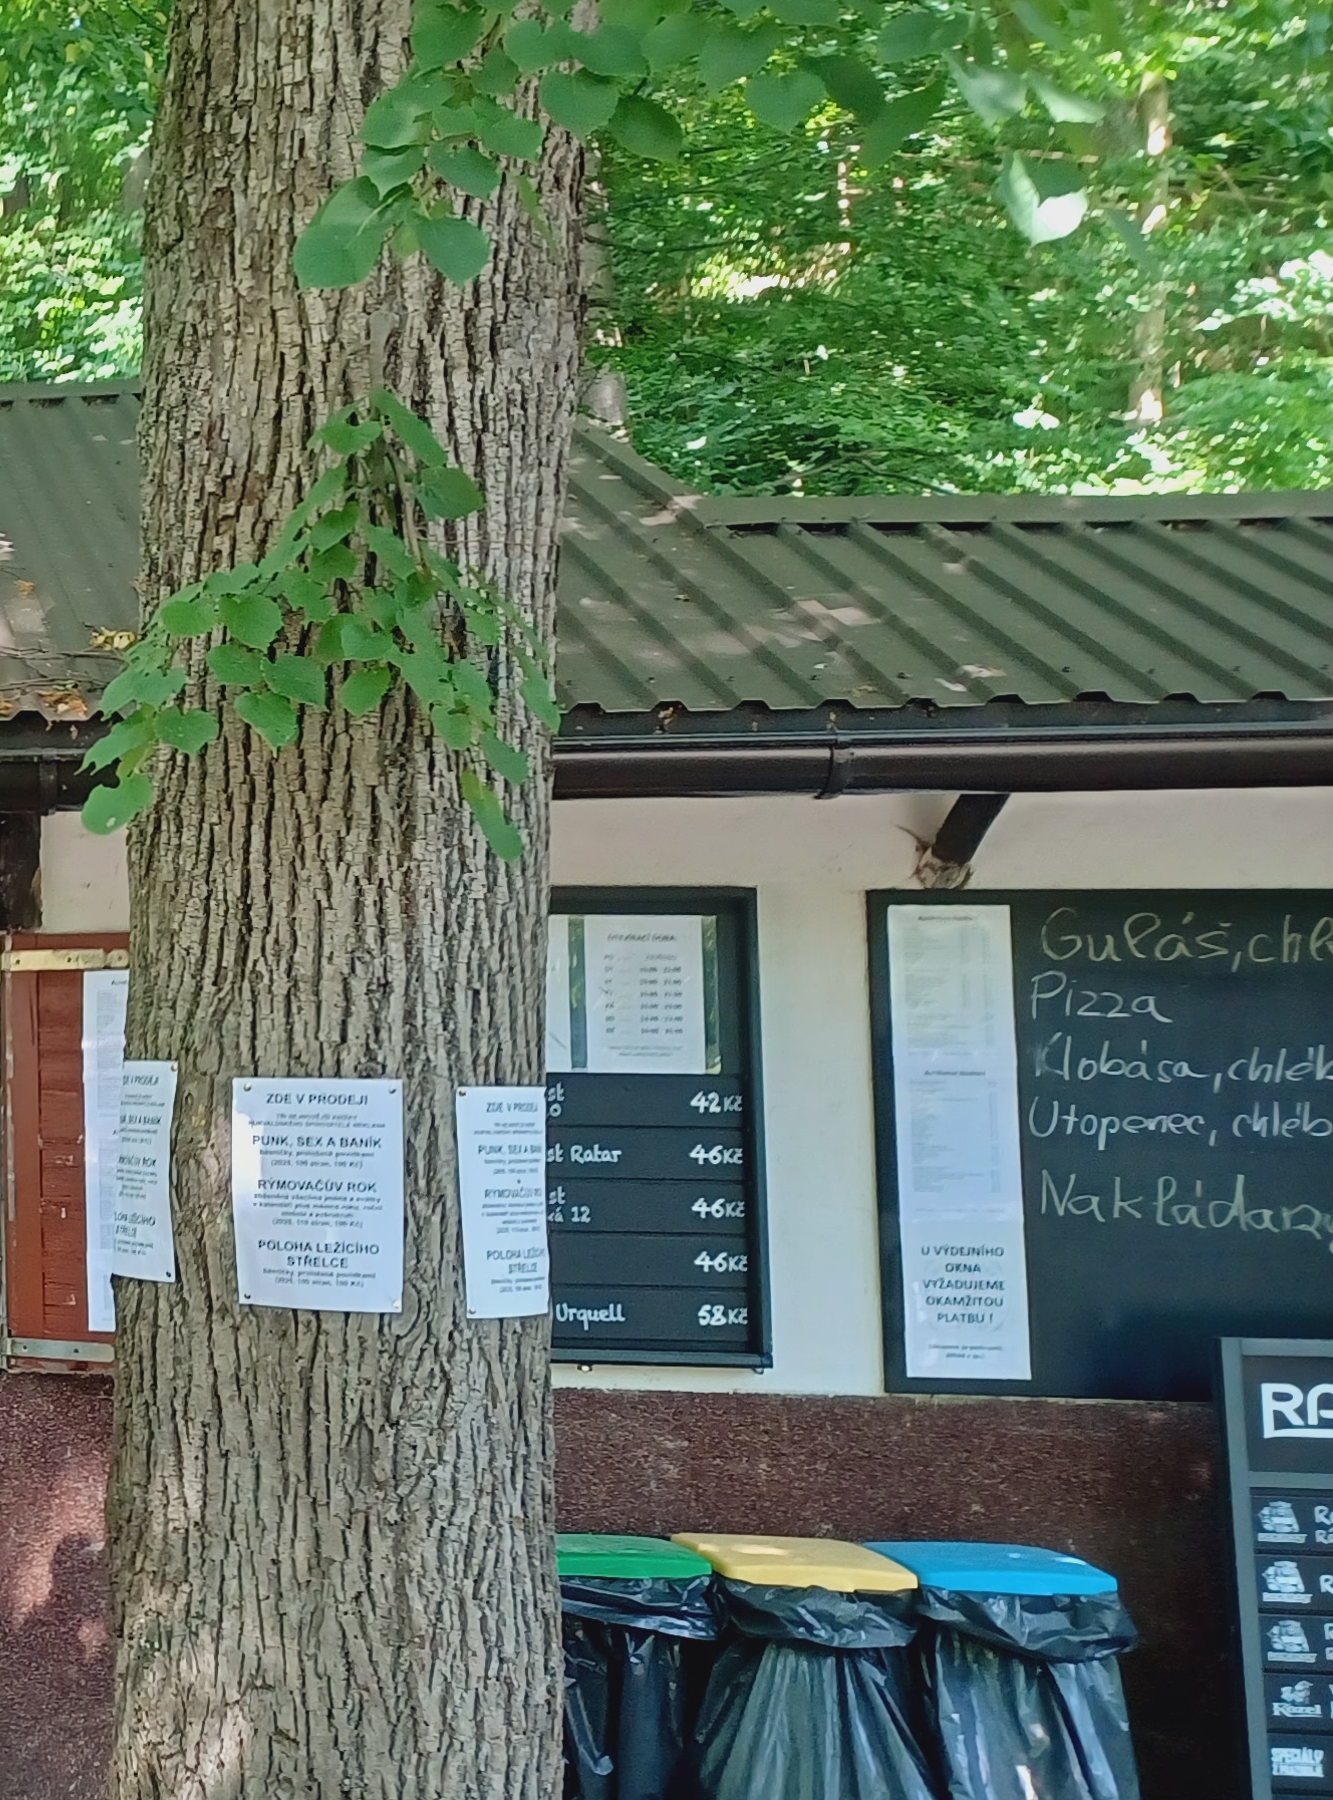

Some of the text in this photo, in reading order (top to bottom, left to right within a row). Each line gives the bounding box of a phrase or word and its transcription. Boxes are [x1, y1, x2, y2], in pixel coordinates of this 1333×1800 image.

[1031, 970, 1174, 1024] Pizza
[266, 1093, 369, 1106] ZDE V PRODEJI
[1028, 1096, 1333, 1151] Utopenec, chléb
[252, 1135, 382, 1149] PUNK, SEX A BANÍK
[570, 1143, 623, 1164] Ratar
[347, 1181, 377, 1193] ROK
[570, 1205, 591, 1223] 12
[258, 1239, 380, 1255] POLOHA LEŽÍCÍHO
[921, 1244, 1004, 1257] U VÝDEJNÍHO
[287, 1255, 349, 1268] STŘELCE
[945, 1262, 981, 1273] OKNA
[922, 1277, 1006, 1291] VYŽADUJEME
[925, 1295, 1004, 1307] OKAMŽITOU
[555, 1303, 627, 1331] Urquell
[937, 1312, 985, 1324] PLATBU
